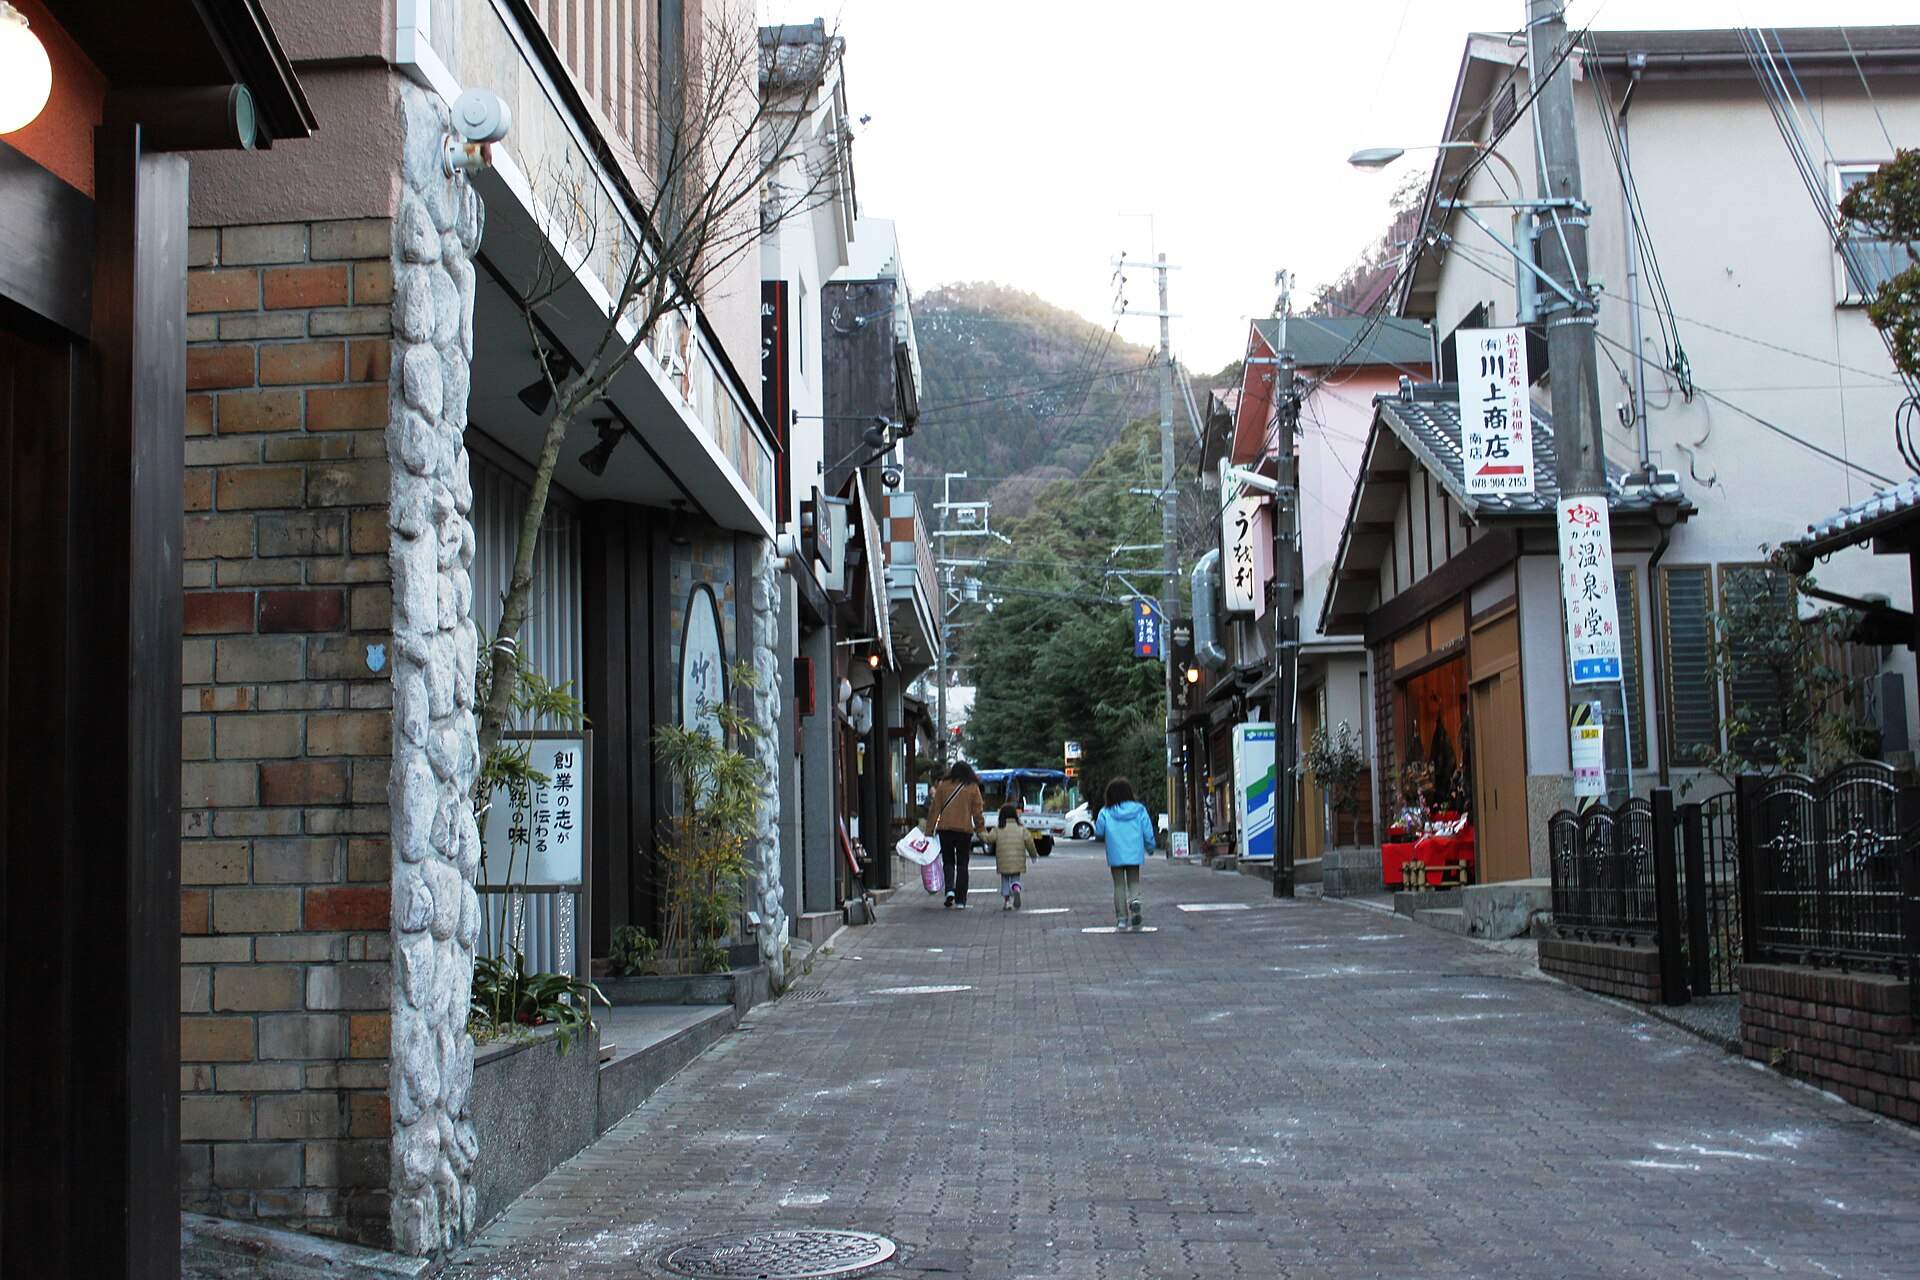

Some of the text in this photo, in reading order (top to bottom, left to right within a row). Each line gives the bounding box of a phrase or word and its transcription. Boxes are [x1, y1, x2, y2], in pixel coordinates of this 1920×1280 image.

[1469, 432, 1482, 460] 南店
[1578, 542, 1603, 638] 温泉堂
[553, 751, 574, 844] 創業の志が
